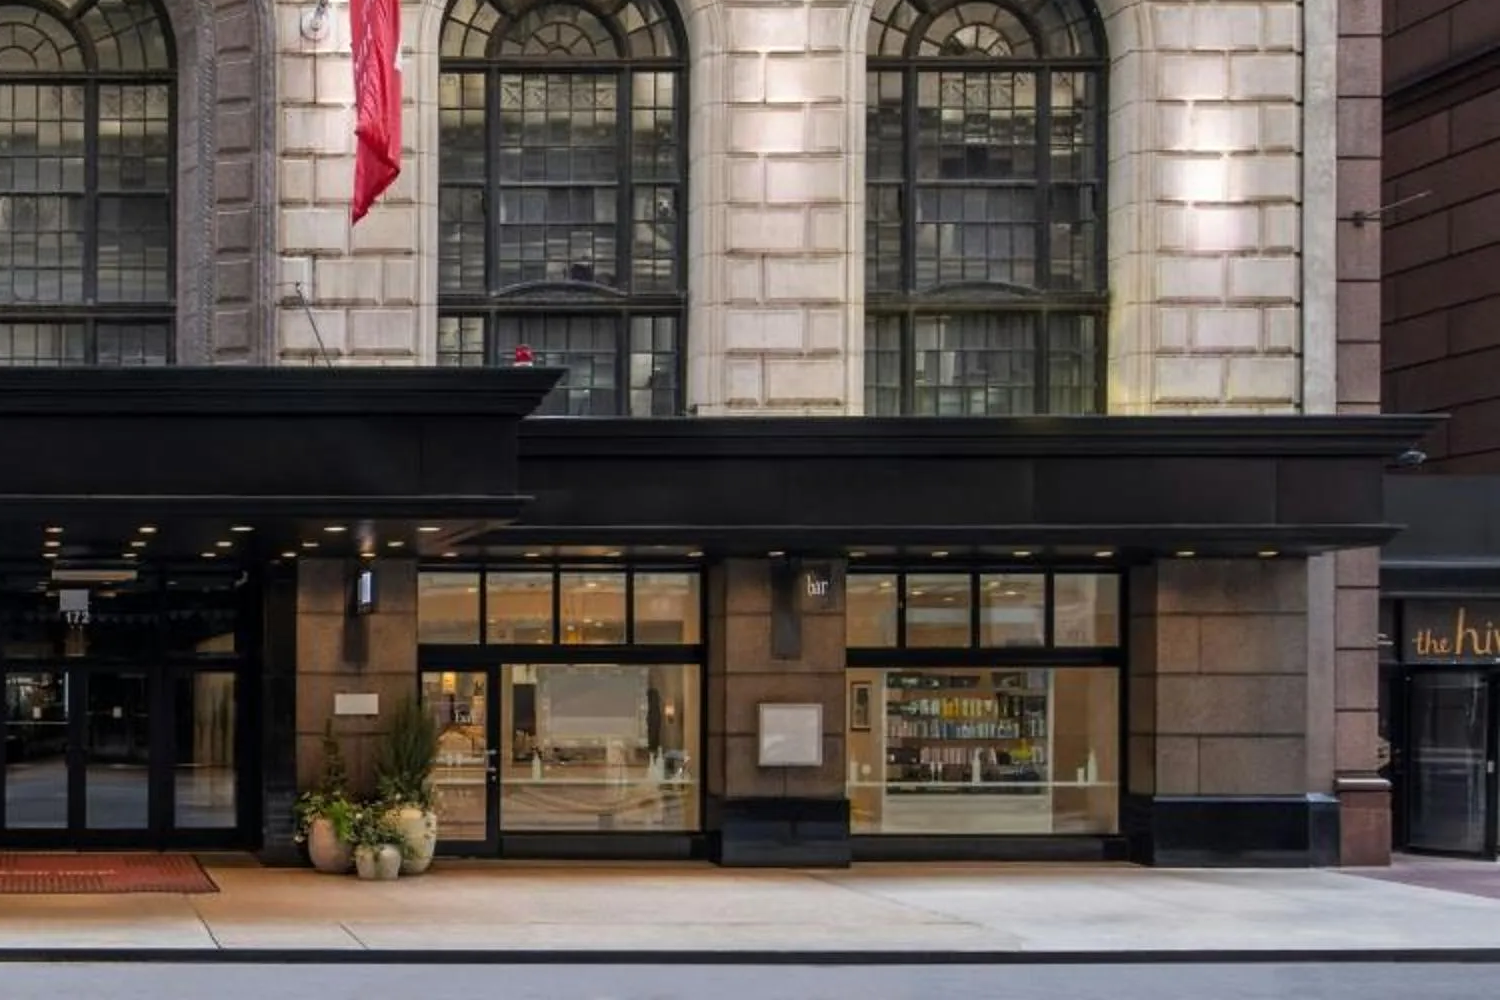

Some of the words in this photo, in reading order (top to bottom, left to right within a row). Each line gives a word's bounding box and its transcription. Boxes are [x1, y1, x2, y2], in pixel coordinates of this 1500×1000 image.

[807, 574, 828, 596] bar
[67, 611, 90, 624] 172
[1412, 629, 1451, 655] the
